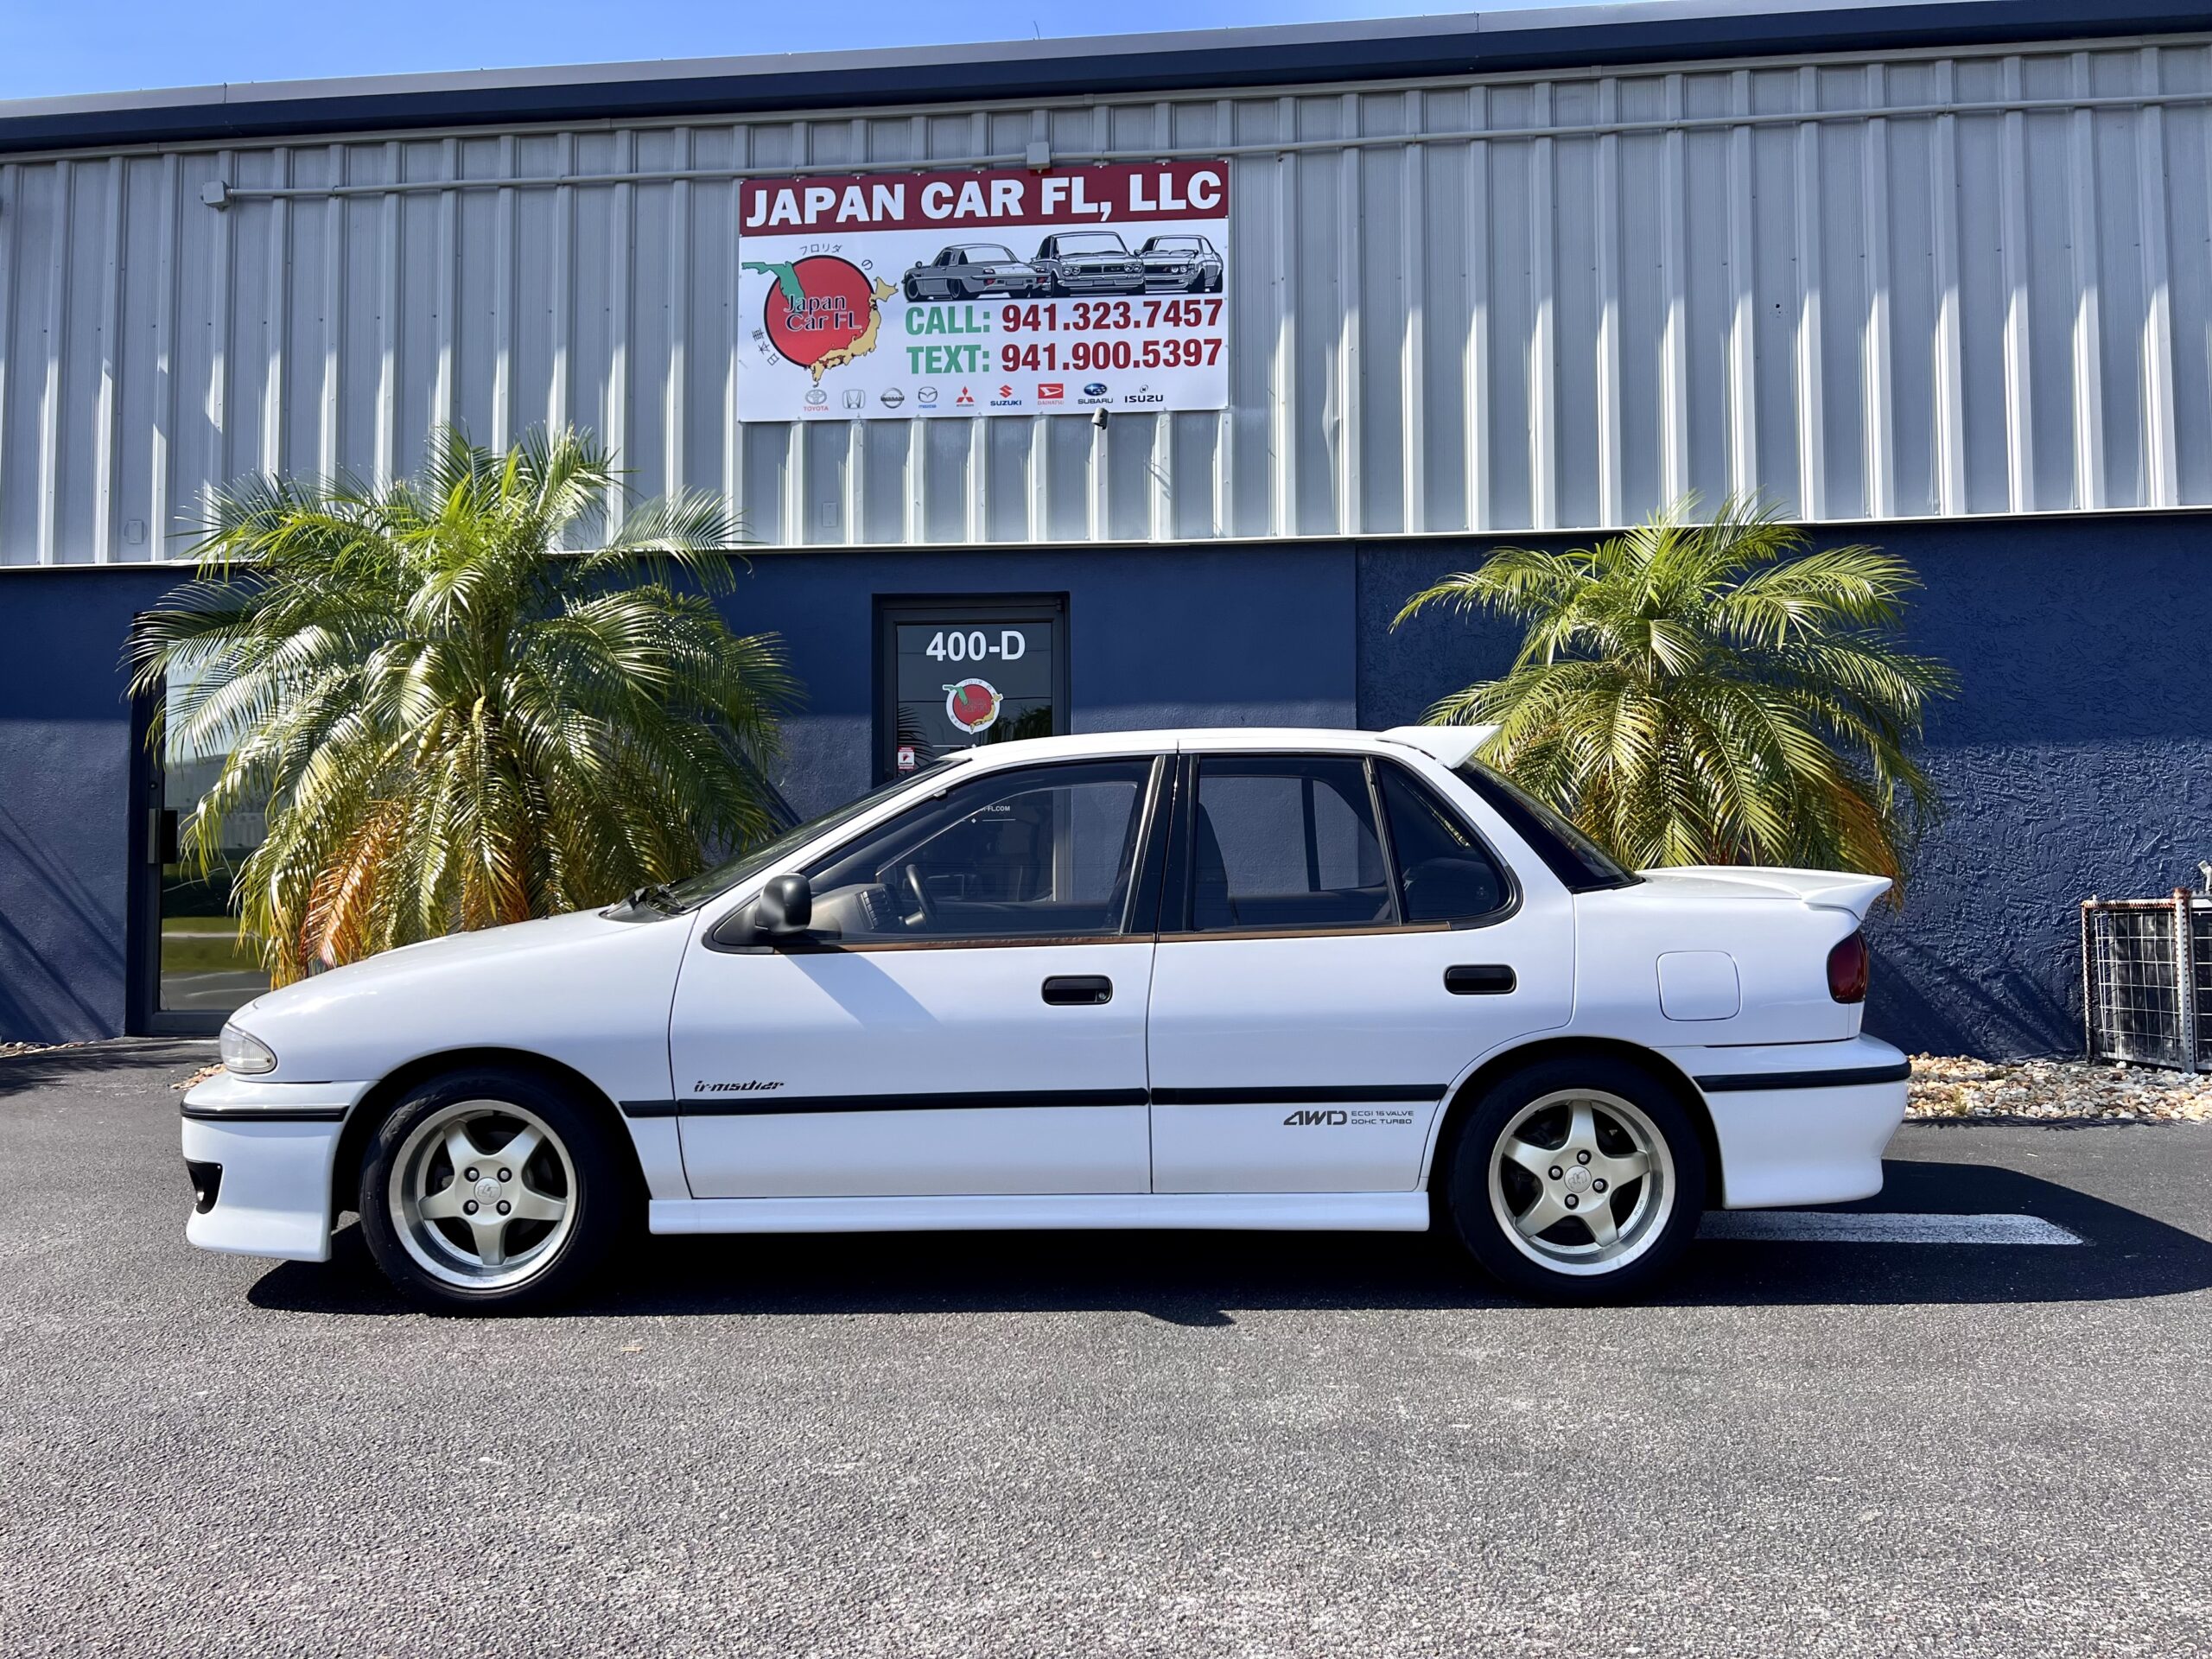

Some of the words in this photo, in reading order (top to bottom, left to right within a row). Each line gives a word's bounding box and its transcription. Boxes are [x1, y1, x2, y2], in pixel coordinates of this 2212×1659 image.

[746, 183, 906, 227] JAPAN
[920, 179, 1025, 219] CAR
[1041, 176, 1112, 222] FL,
[1129, 170, 1222, 212] LLC
[799, 243, 842, 256] フロリダ
[861, 259, 874, 270] の
[784, 295, 847, 316] Japan
[786, 314, 829, 331] Car
[834, 311, 862, 330] FL
[906, 305, 990, 335] CALL:
[1002, 299, 1223, 333] 941.323.7457
[906, 345, 990, 374] TEXT:
[1001, 339, 1222, 372] 941.900.5397
[1124, 394, 1164, 404] ISUZU
[925, 630, 1026, 661] 400-D
[1283, 1110, 1347, 1125] AWD
